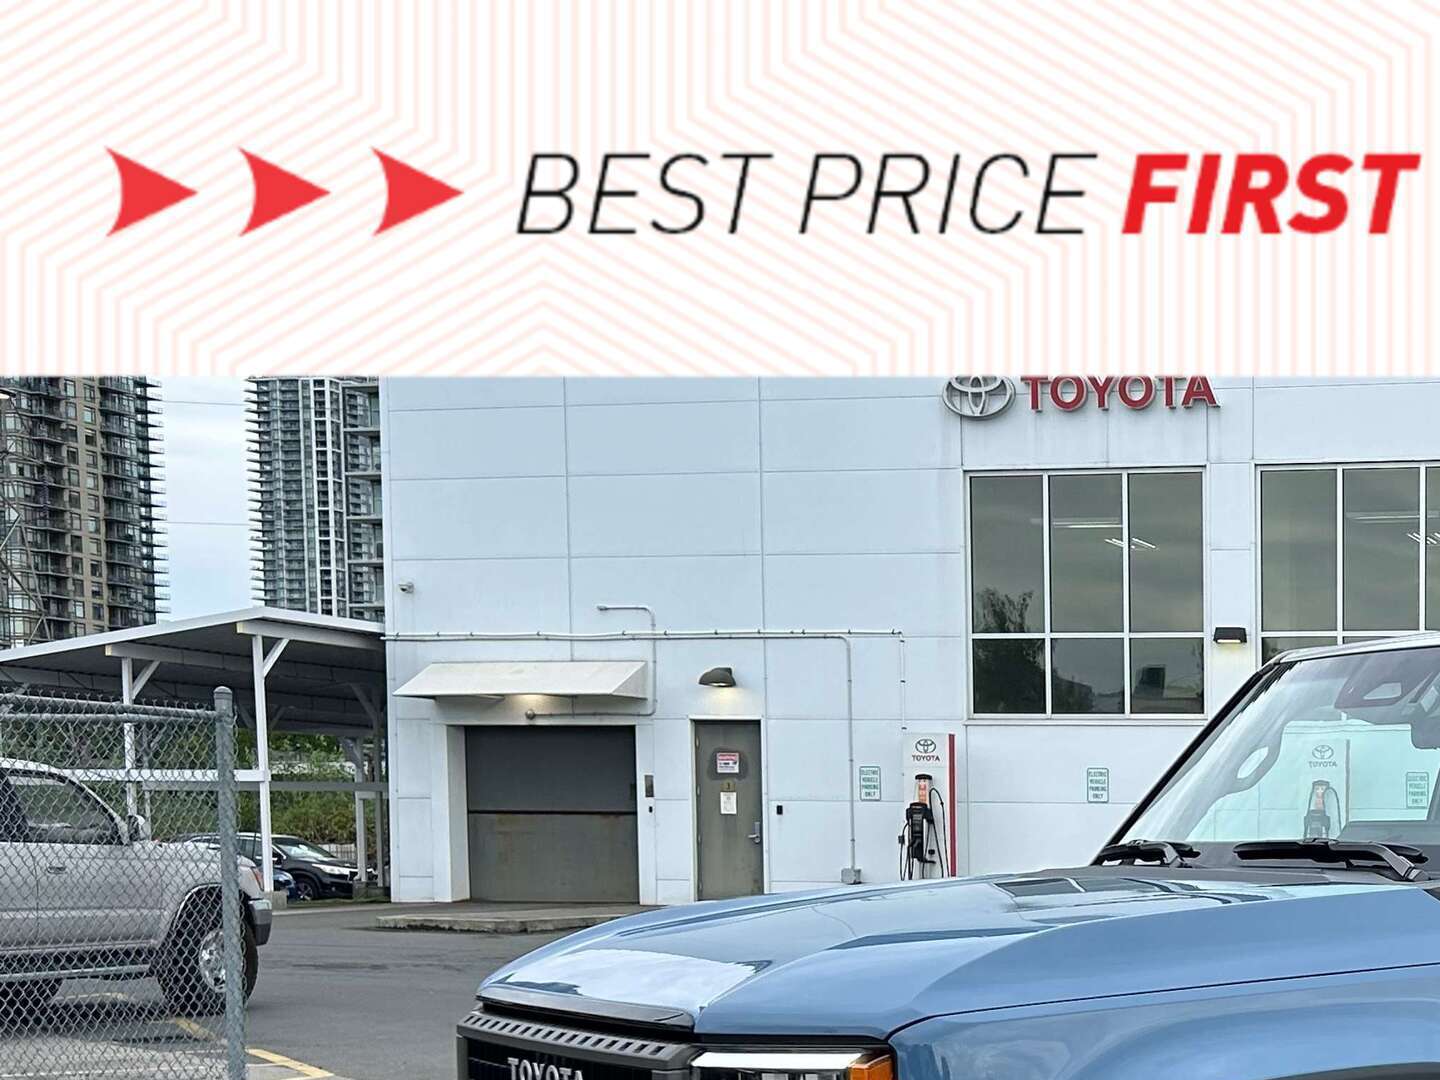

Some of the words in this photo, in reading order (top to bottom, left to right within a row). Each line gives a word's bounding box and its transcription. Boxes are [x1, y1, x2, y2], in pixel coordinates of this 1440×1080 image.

[1021, 375, 1221, 412] TOYOTA
[912, 754, 941, 762] TOYOTA
[1308, 760, 1338, 768] TOYOTA
